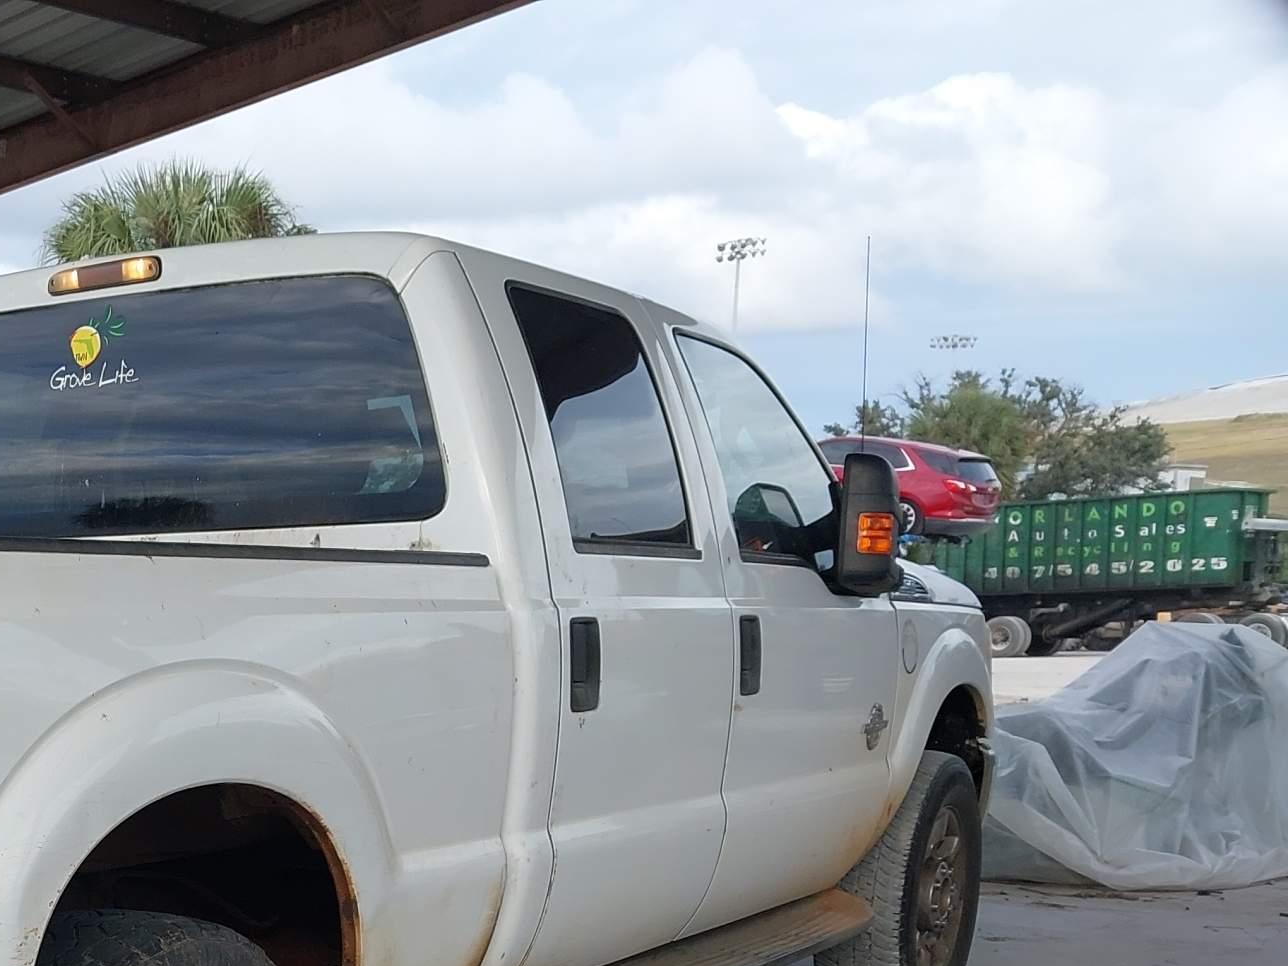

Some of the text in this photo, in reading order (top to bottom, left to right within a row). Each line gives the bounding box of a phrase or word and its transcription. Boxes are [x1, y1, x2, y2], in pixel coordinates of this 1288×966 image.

[50, 360, 139, 391] Grove Life
[1007, 501, 1186, 526] ORLANDO
[1114, 522, 1186, 539] Sales
[1033, 542, 1181, 557] Recycling
